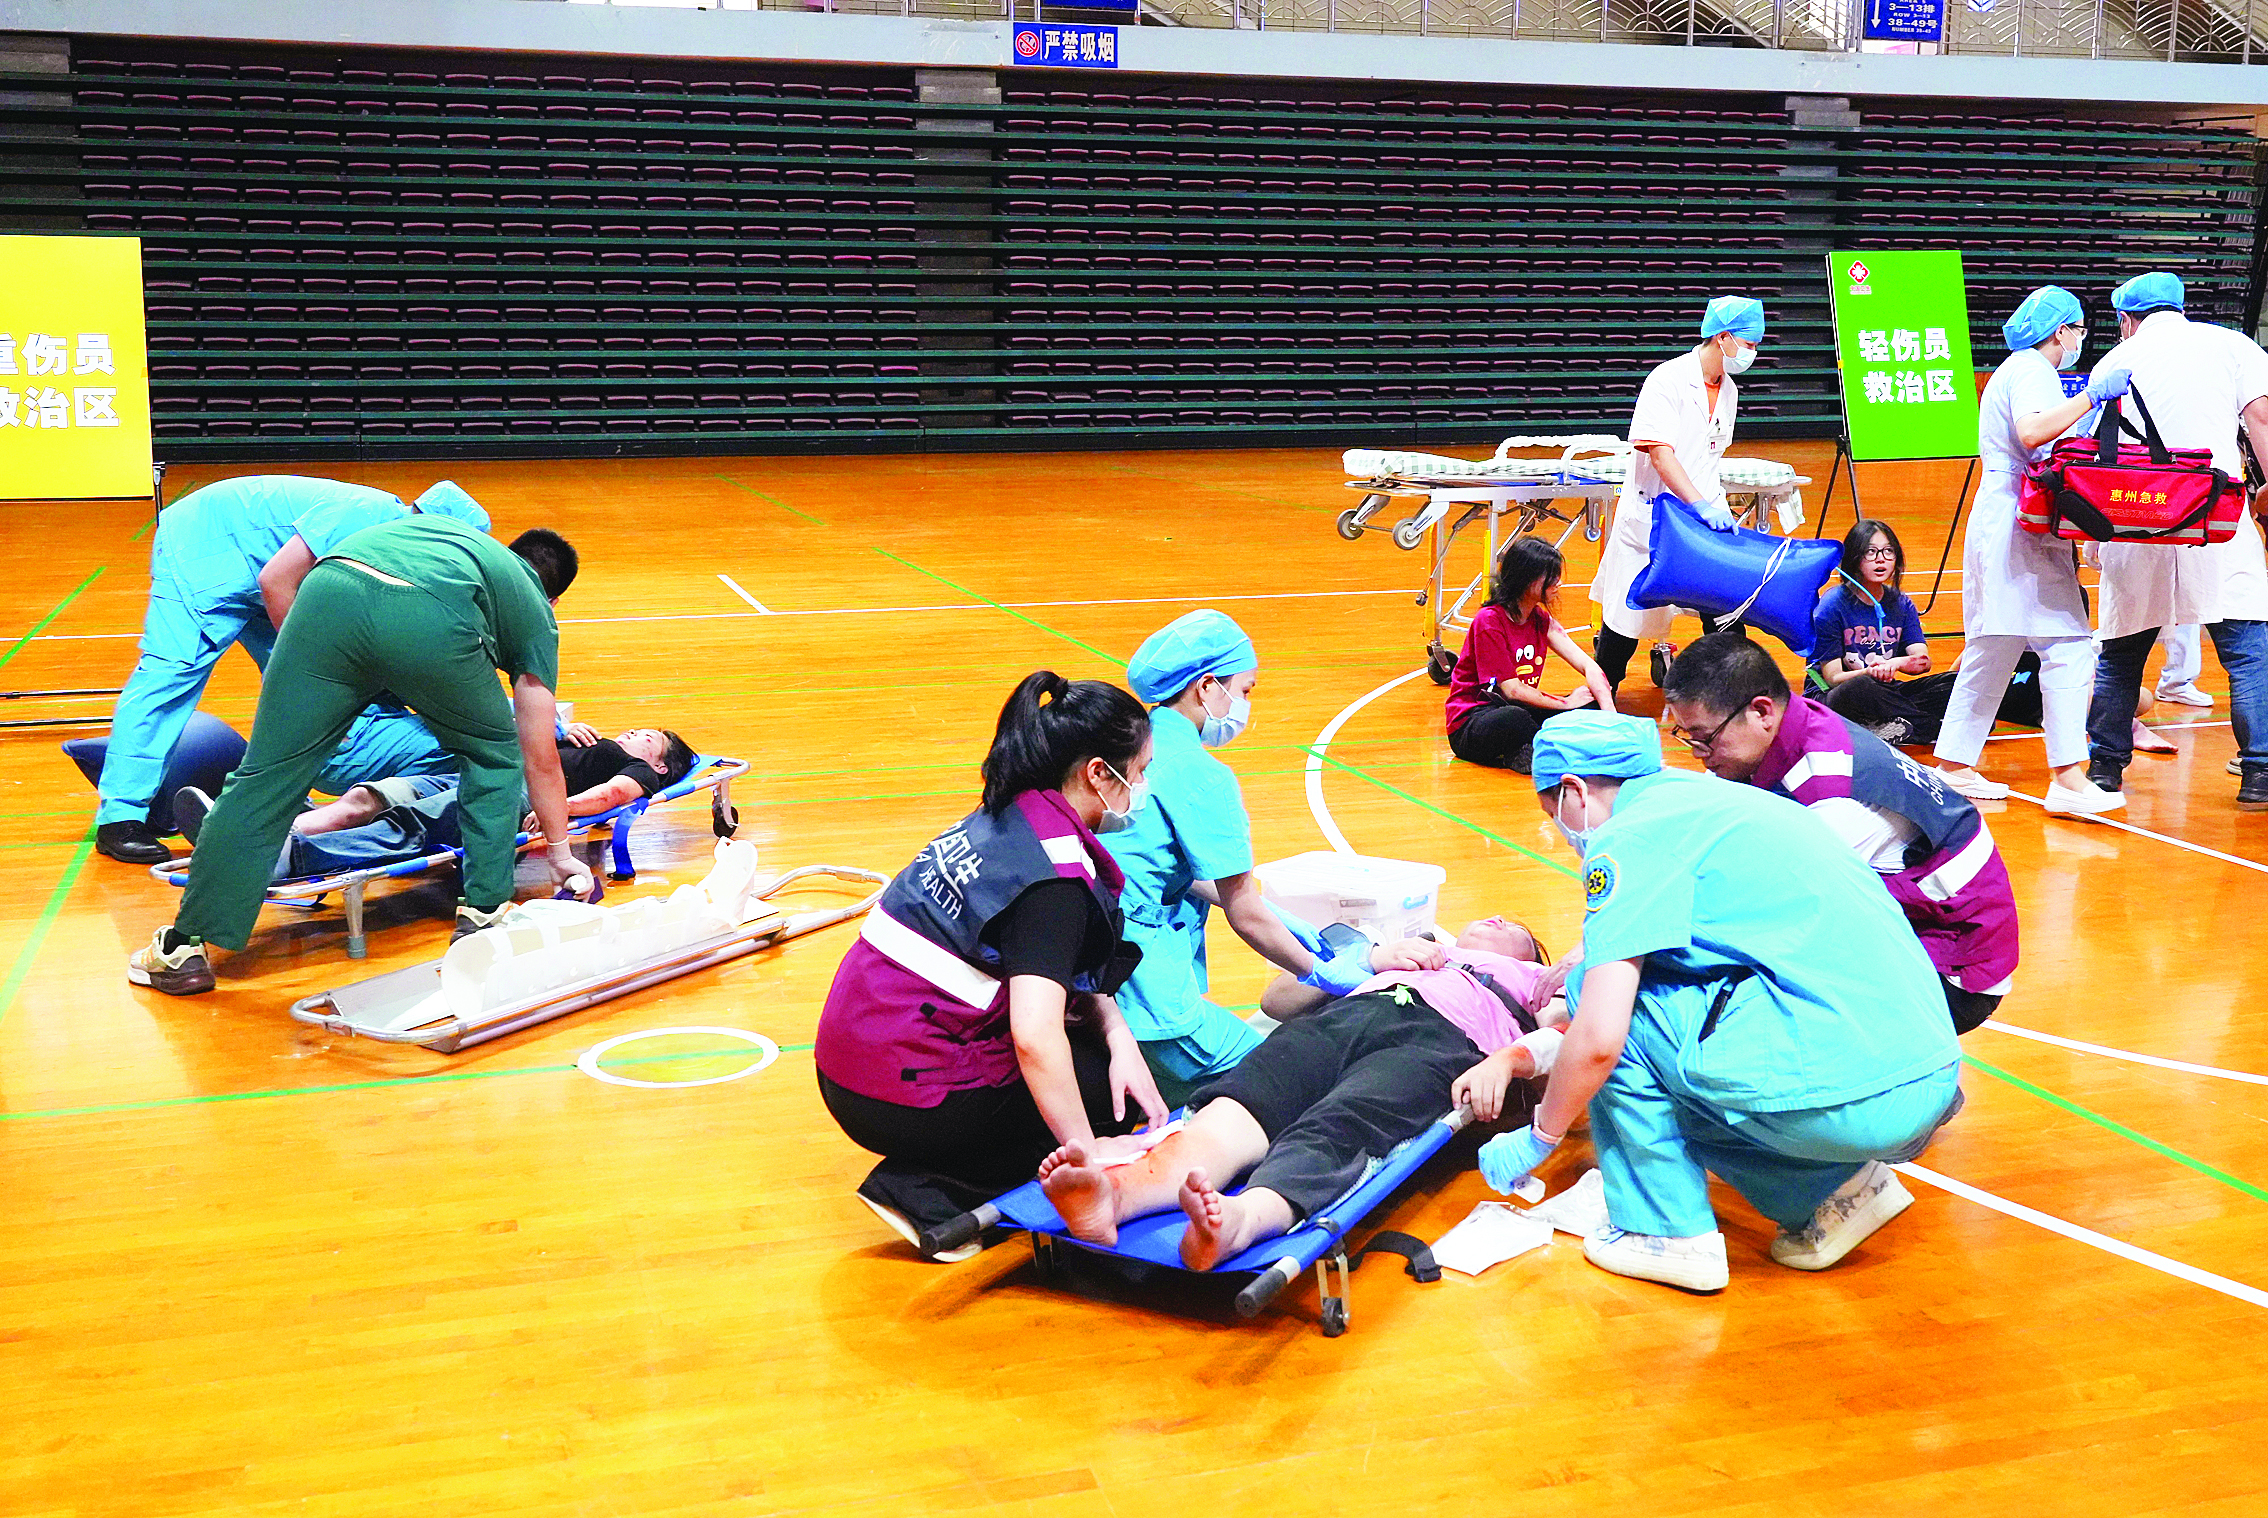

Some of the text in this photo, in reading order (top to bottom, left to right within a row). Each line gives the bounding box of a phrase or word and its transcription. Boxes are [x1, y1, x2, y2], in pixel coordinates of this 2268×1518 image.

[1043, 30, 1115, 62] 严禁吸烟
[1858, 328, 1951, 362] 轻伤员
[1863, 370, 1957, 403] 救治区
[2109, 489, 2167, 505] 惠州急救
[919, 865, 963, 920] HEALTH
